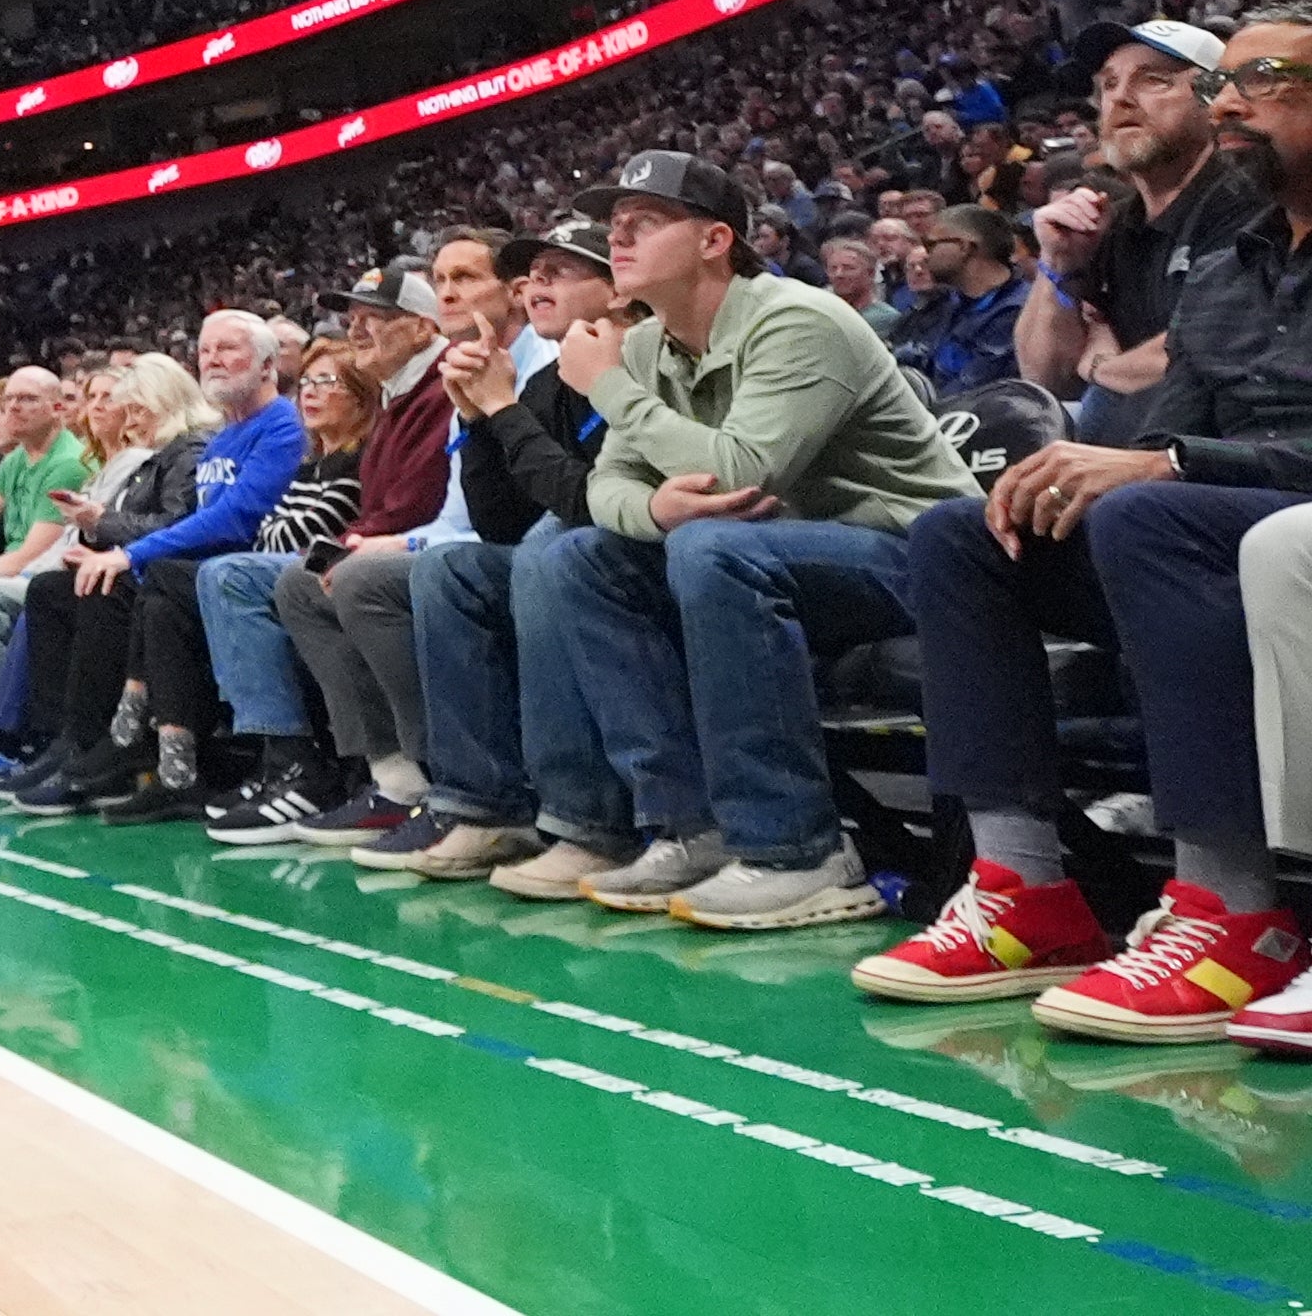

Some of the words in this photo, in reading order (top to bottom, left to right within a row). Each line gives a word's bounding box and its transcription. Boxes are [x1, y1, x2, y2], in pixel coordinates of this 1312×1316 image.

[417, 85, 478, 116] NOTHING
[478, 75, 507, 98] BUT
[507, 21, 648, 91] ONE-OF-A-KIND
